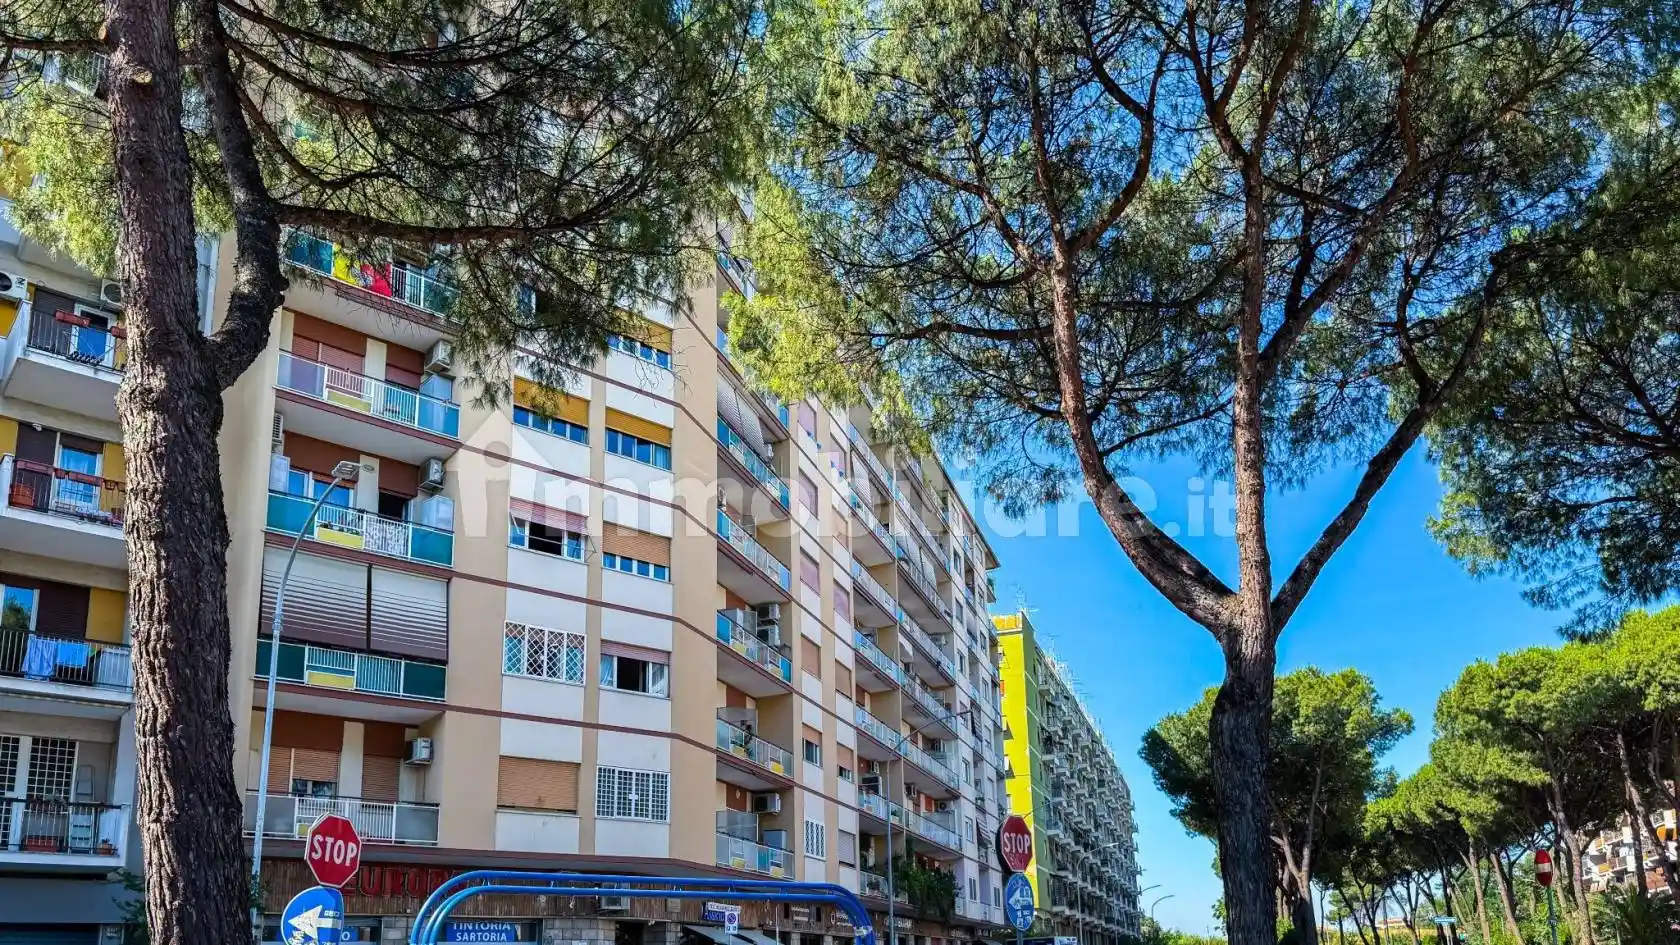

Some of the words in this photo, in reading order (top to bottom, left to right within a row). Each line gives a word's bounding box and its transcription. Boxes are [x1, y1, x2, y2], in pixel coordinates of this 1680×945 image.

[311, 835, 357, 866] STOP
[1004, 832, 1030, 854] STOP
[453, 922, 511, 931] TINTORIA
[456, 932, 507, 942] SARTORIA
